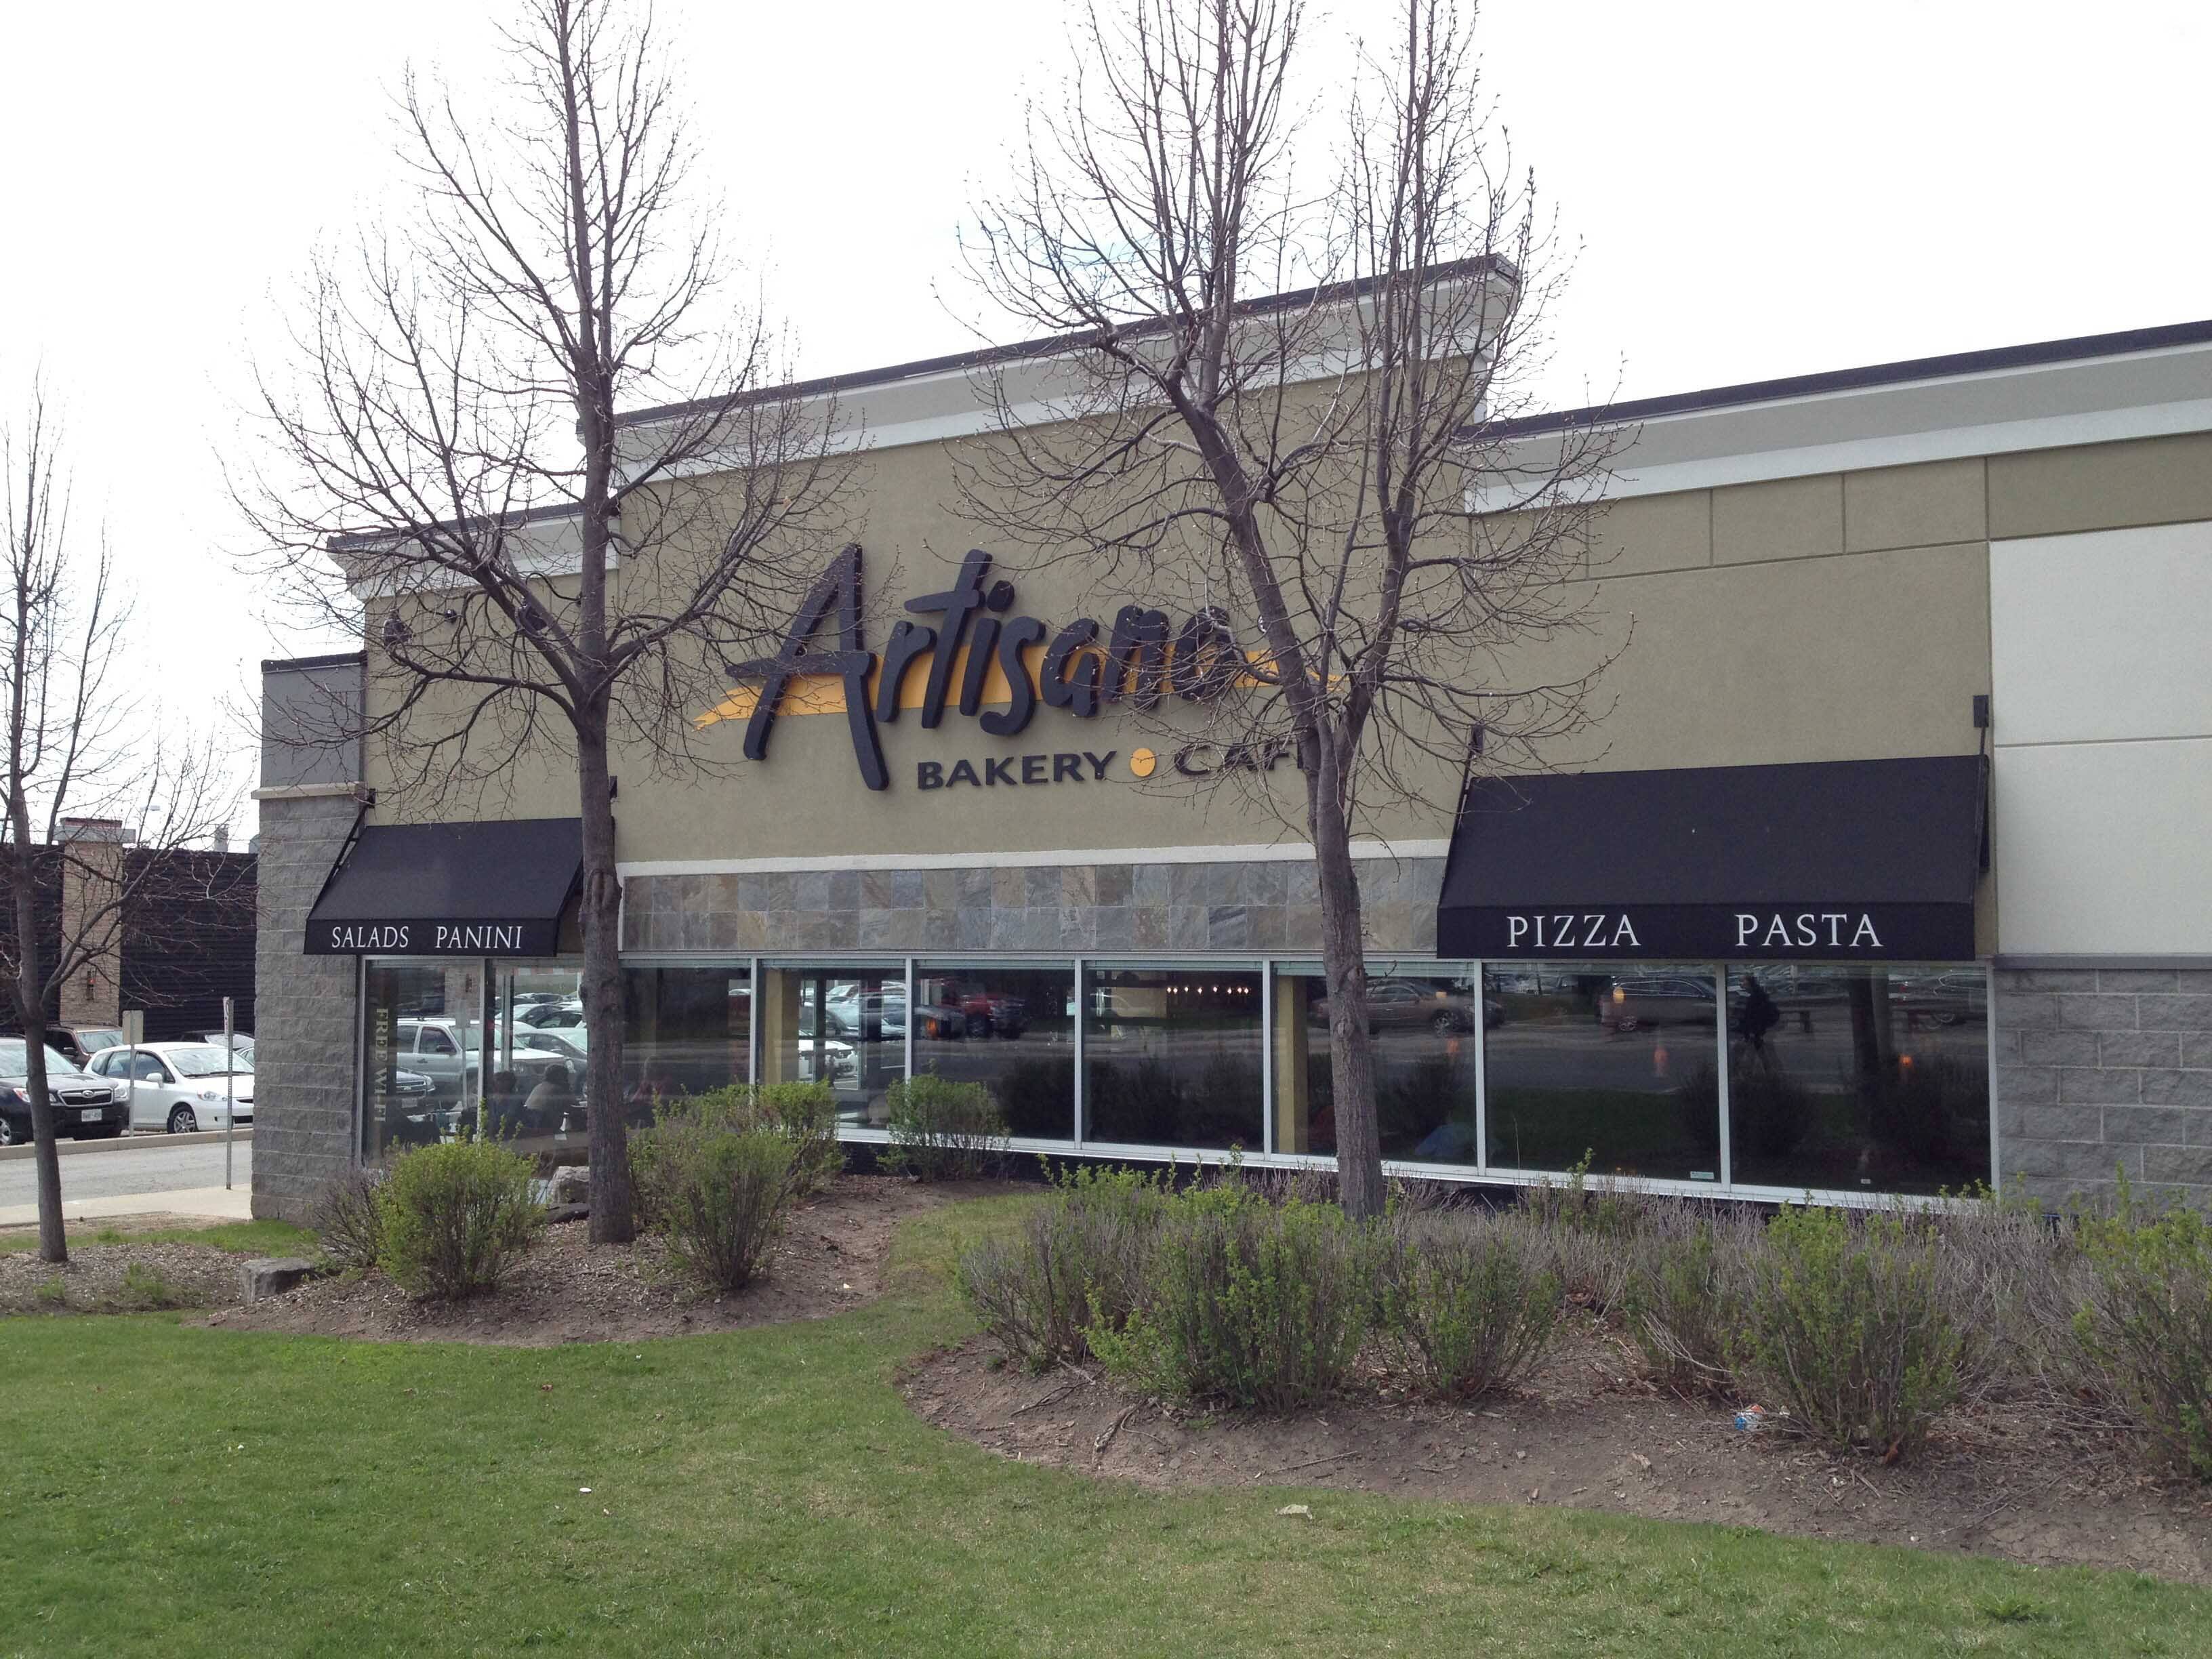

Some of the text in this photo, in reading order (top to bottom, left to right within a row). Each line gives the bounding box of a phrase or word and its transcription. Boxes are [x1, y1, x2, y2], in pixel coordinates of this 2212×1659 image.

[725, 543, 1236, 791] Artisano
[918, 739, 1303, 789] BAKERY CAF
[331, 925, 523, 949] SALADS PANINI
[1507, 913, 1883, 947] PIZZA PASTA
[375, 1008, 388, 1062] FREE
